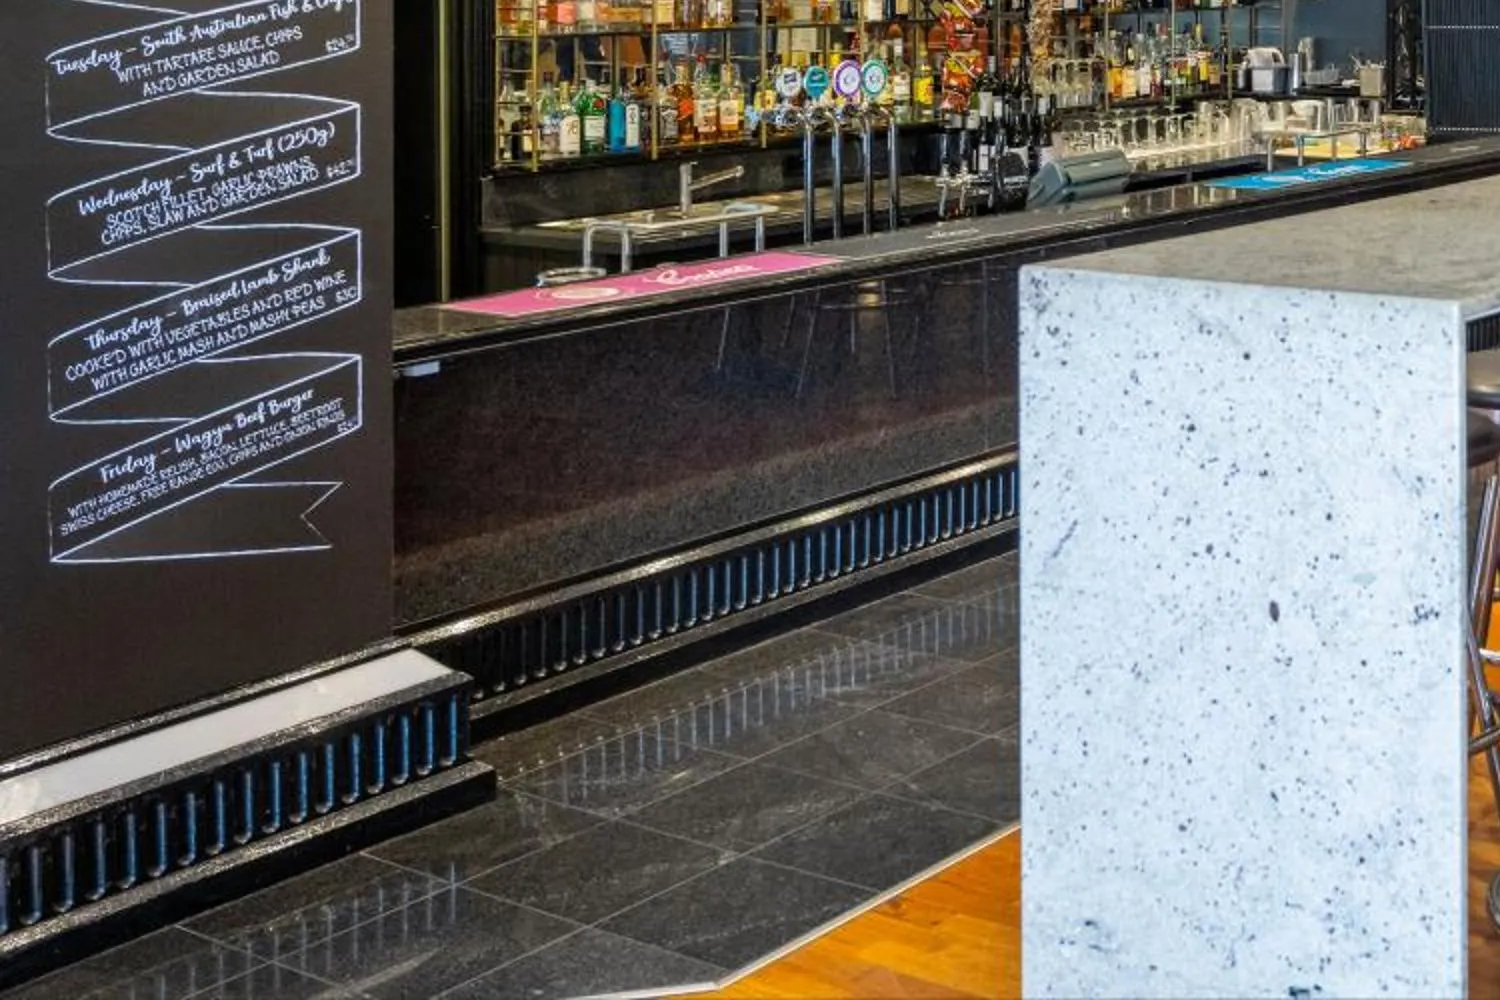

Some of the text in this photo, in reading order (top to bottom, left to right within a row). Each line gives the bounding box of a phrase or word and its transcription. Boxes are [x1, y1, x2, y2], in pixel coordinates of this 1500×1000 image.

[50, 49, 123, 75] Tuesday
[141, 26, 186, 56] South
[189, 12, 267, 42] Australian
[115, 61, 153, 83] WITH
[154, 47, 216, 74] TARTARE
[266, 25, 303, 47] CHIPS
[143, 76, 177, 97] AND
[178, 62, 236, 87] GARDEN
[237, 50, 280, 72] SALAD
[78, 177, 173, 216] Wednesday
[190, 153, 225, 182] Surf
[228, 152, 242, 169] &
[244, 138, 274, 163] Turf
[277, 121, 335, 152] (250g)
[149, 210, 184, 230] SLAW
[187, 196, 219, 219] AND
[221, 182, 277, 207] GARDEN
[278, 168, 319, 190] SALAD
[106, 201, 161, 229] SCOTCH
[211, 172, 253, 197] GARLIC
[84, 315, 163, 350] Thursday
[181, 280, 241, 316] Braised
[281, 248, 331, 282] Shank
[65, 349, 127, 381] COOKED
[127, 335, 165, 357] WITH
[165, 303, 250, 345] VEGETABLES
[251, 294, 283, 315] AND
[284, 283, 313, 303] RED
[91, 368, 128, 391] WITH
[129, 351, 176, 377] GARLIC
[177, 336, 215, 361] MASH
[217, 325, 249, 346] AND
[291, 296, 326, 318] PEAS
[100, 454, 157, 483] Friday
[175, 423, 233, 453] Wagyu
[234, 402, 266, 429] Beef
[267, 389, 314, 415] Burger
[60, 513, 96, 536] SWISS
[67, 498, 97, 518] WITH
[98, 475, 158, 504] HOMEMADE
